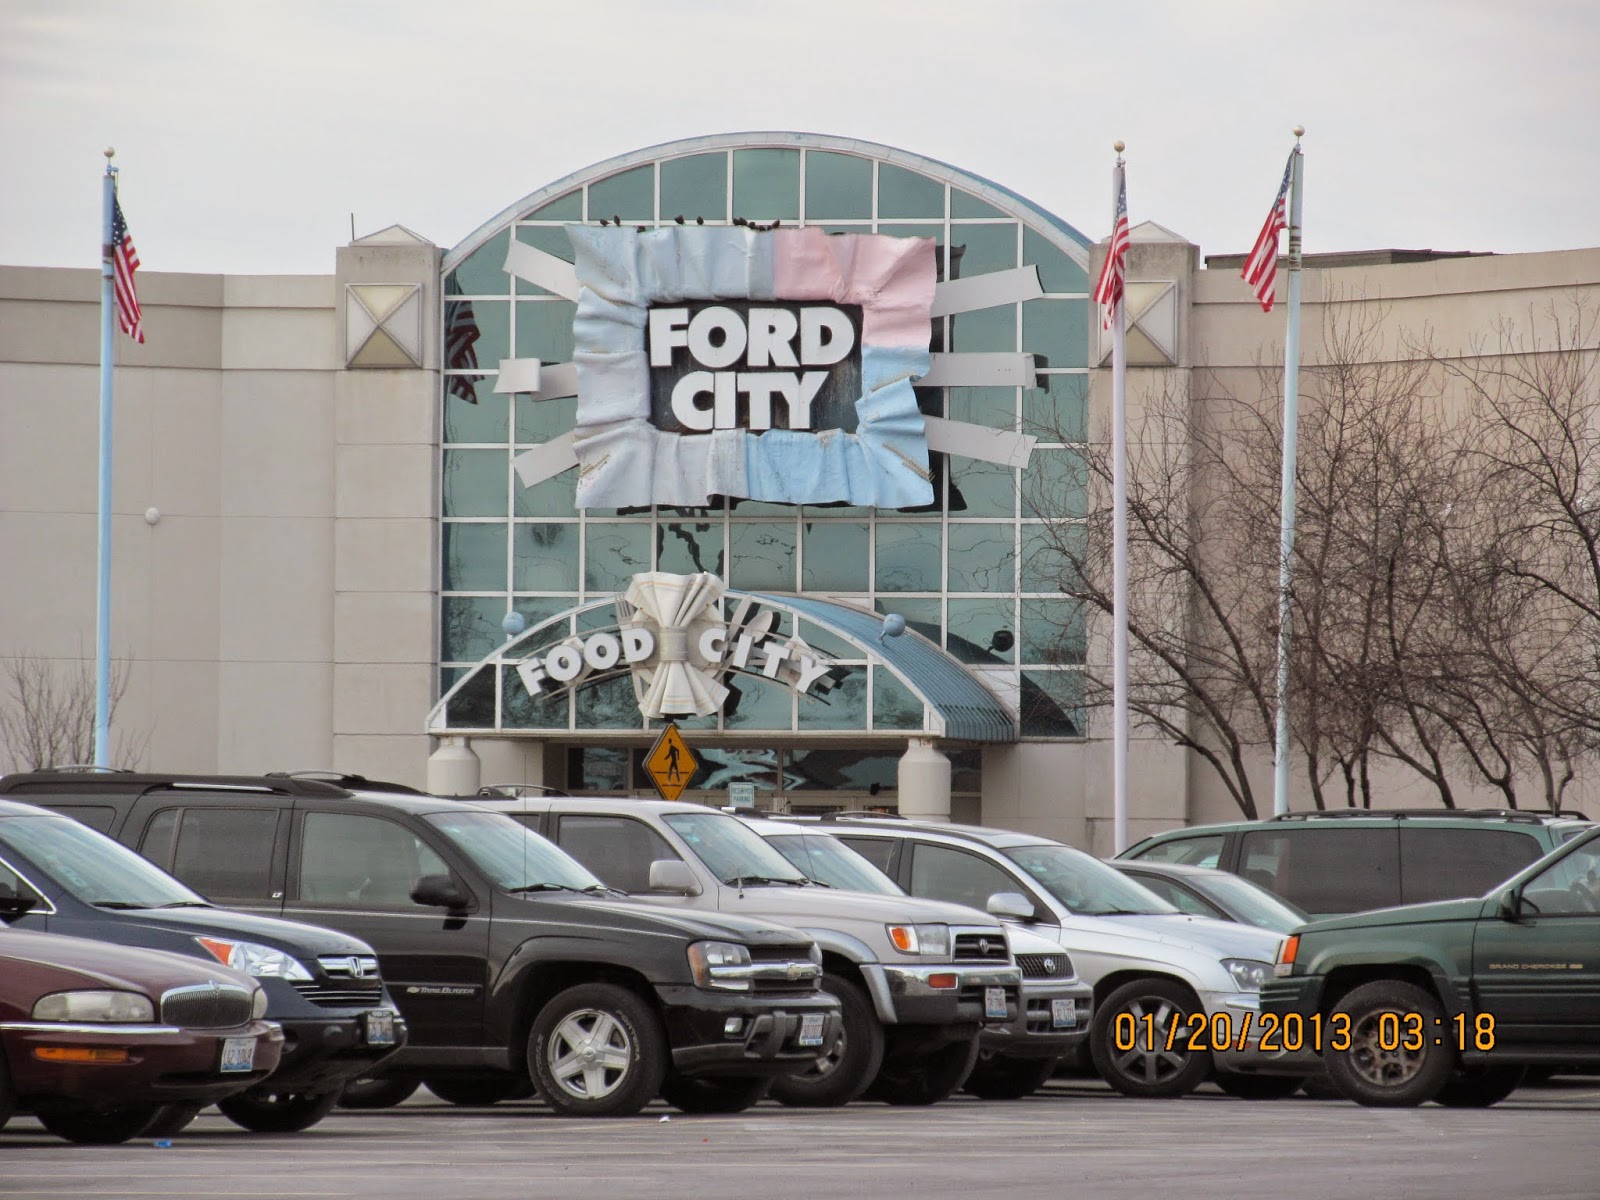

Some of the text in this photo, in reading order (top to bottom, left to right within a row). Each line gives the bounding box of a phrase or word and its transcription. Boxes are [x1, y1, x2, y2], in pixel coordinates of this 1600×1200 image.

[649, 305, 855, 368] FORD
[671, 370, 830, 431] CITY
[516, 627, 834, 696] FOOD CITY
